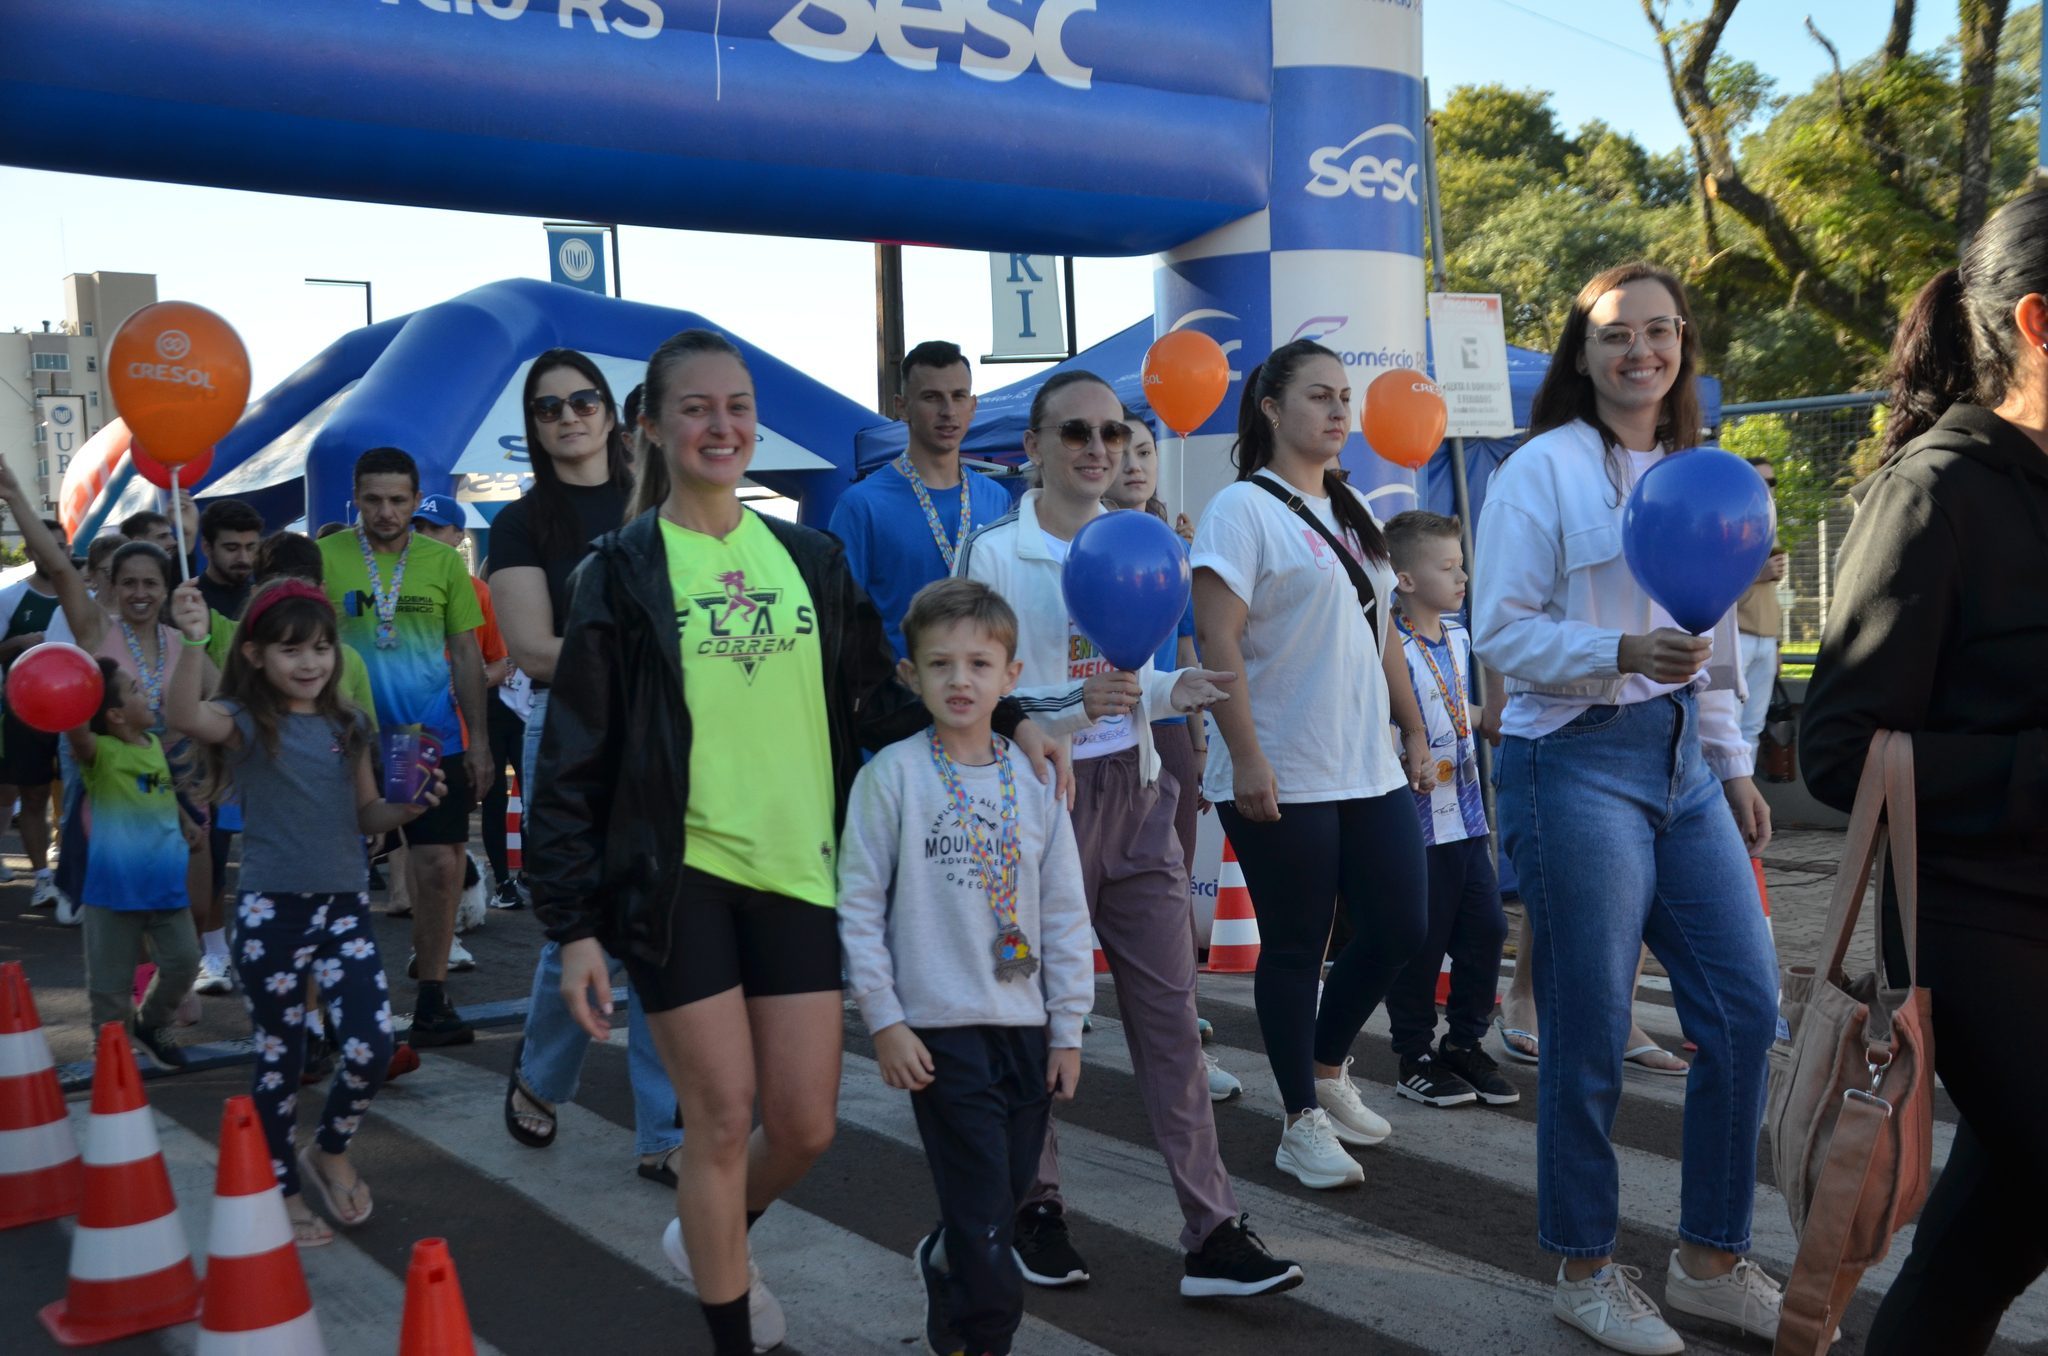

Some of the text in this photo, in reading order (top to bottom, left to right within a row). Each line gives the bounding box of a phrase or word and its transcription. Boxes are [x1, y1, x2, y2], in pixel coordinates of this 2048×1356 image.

[1304, 145, 1419, 206] Sesc
[128, 361, 217, 390] CRESOL
[697, 638, 797, 655] CORREM
[946, 872, 984, 890] OREG
